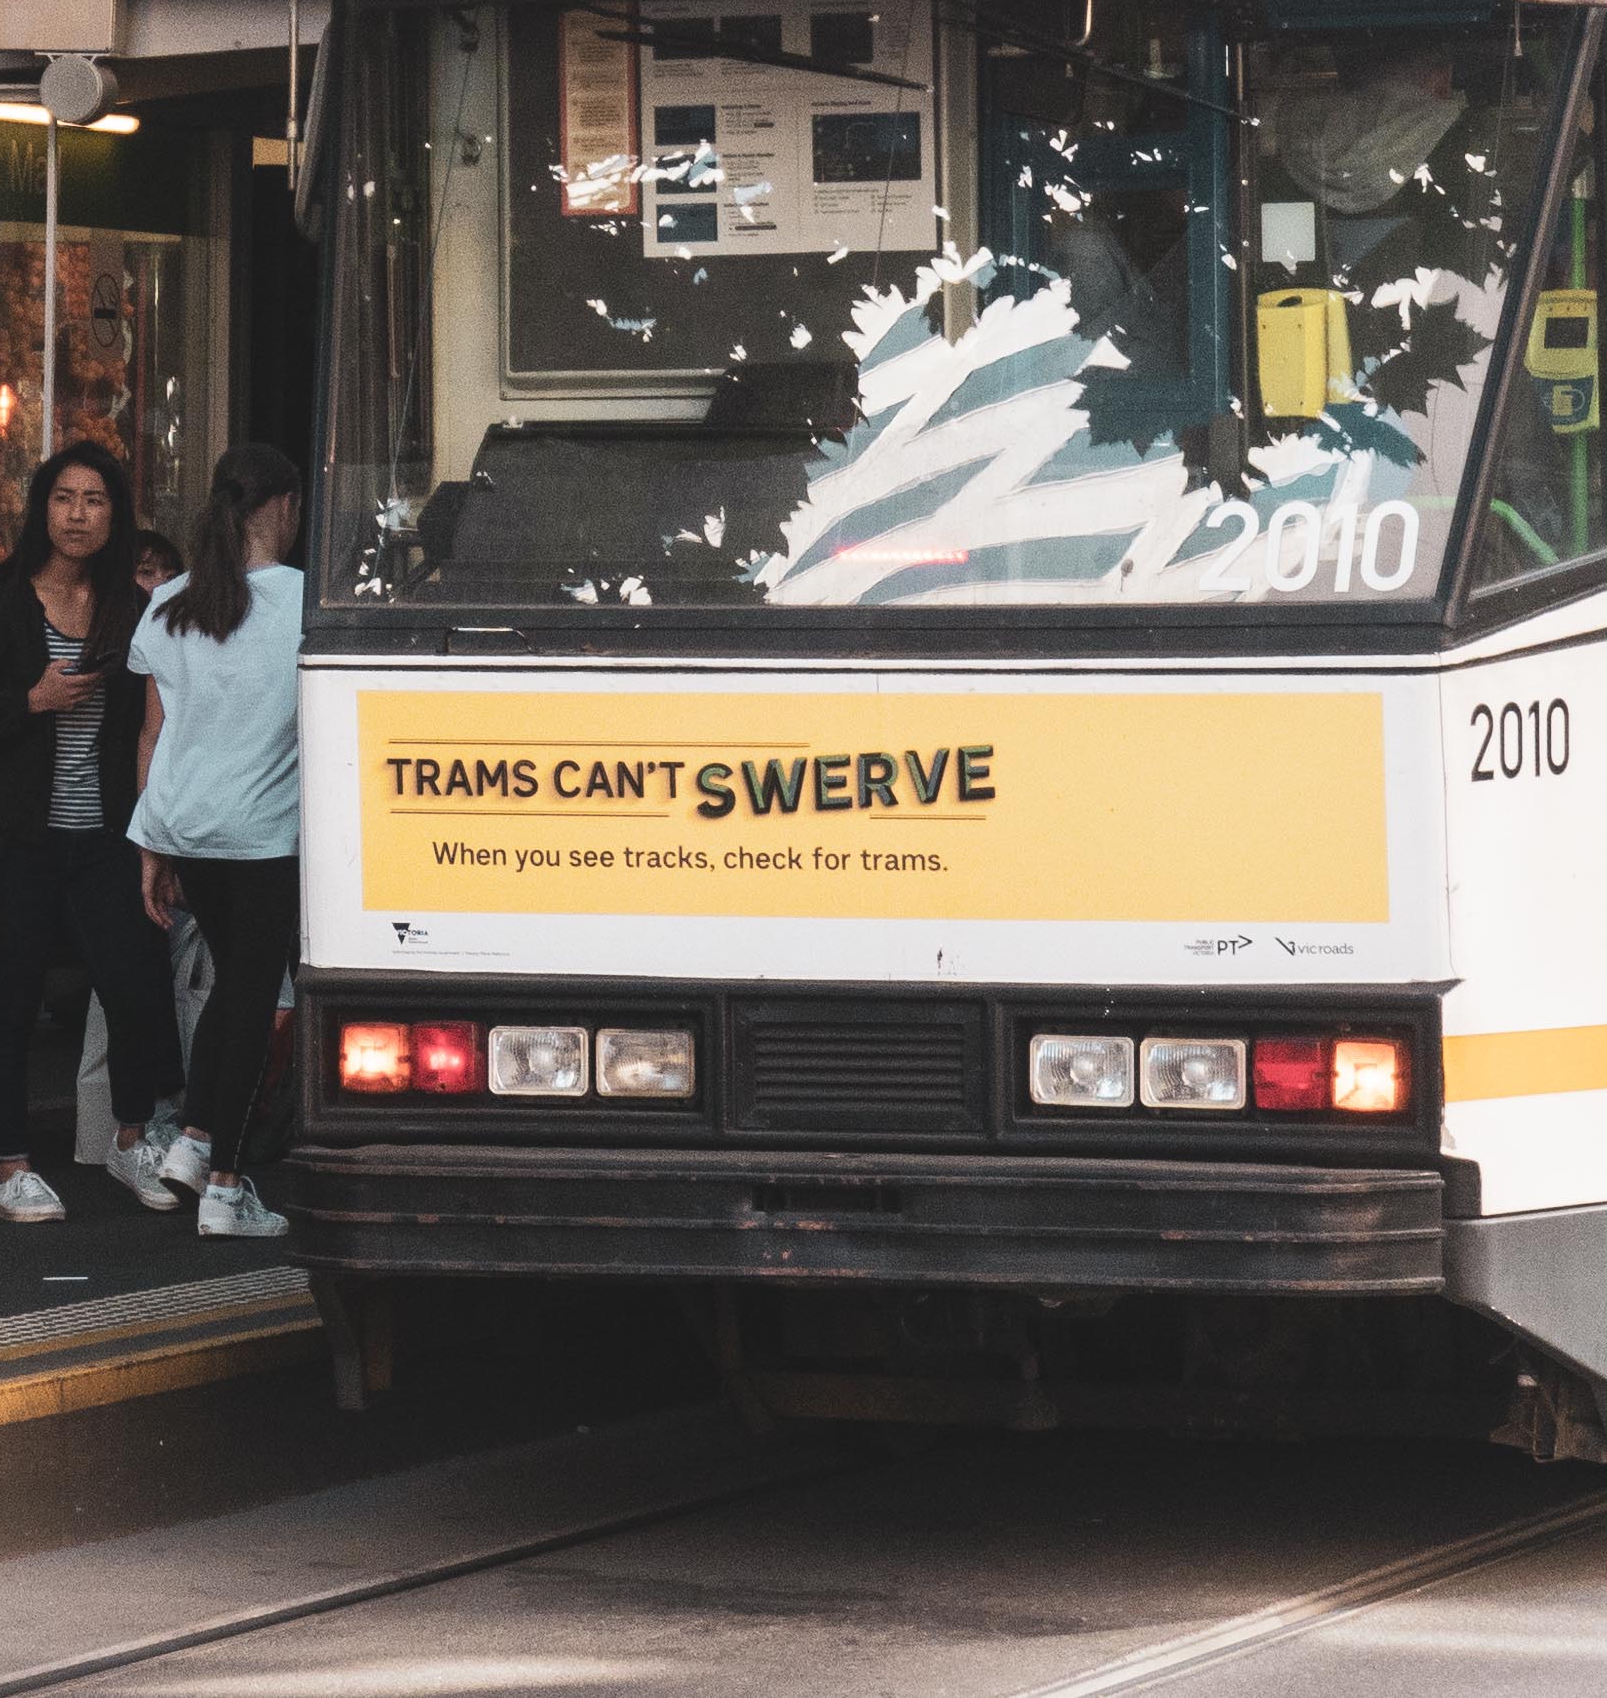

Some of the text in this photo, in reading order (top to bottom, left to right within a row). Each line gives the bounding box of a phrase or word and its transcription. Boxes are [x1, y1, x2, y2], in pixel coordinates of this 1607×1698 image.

[1198, 499, 1420, 594] 2010
[1469, 698, 1571, 782] 2010
[387, 757, 539, 799] TRAMS
[693, 745, 996, 820] SWERVE
[431, 842, 949, 873] When you see tracks, check for trams.
